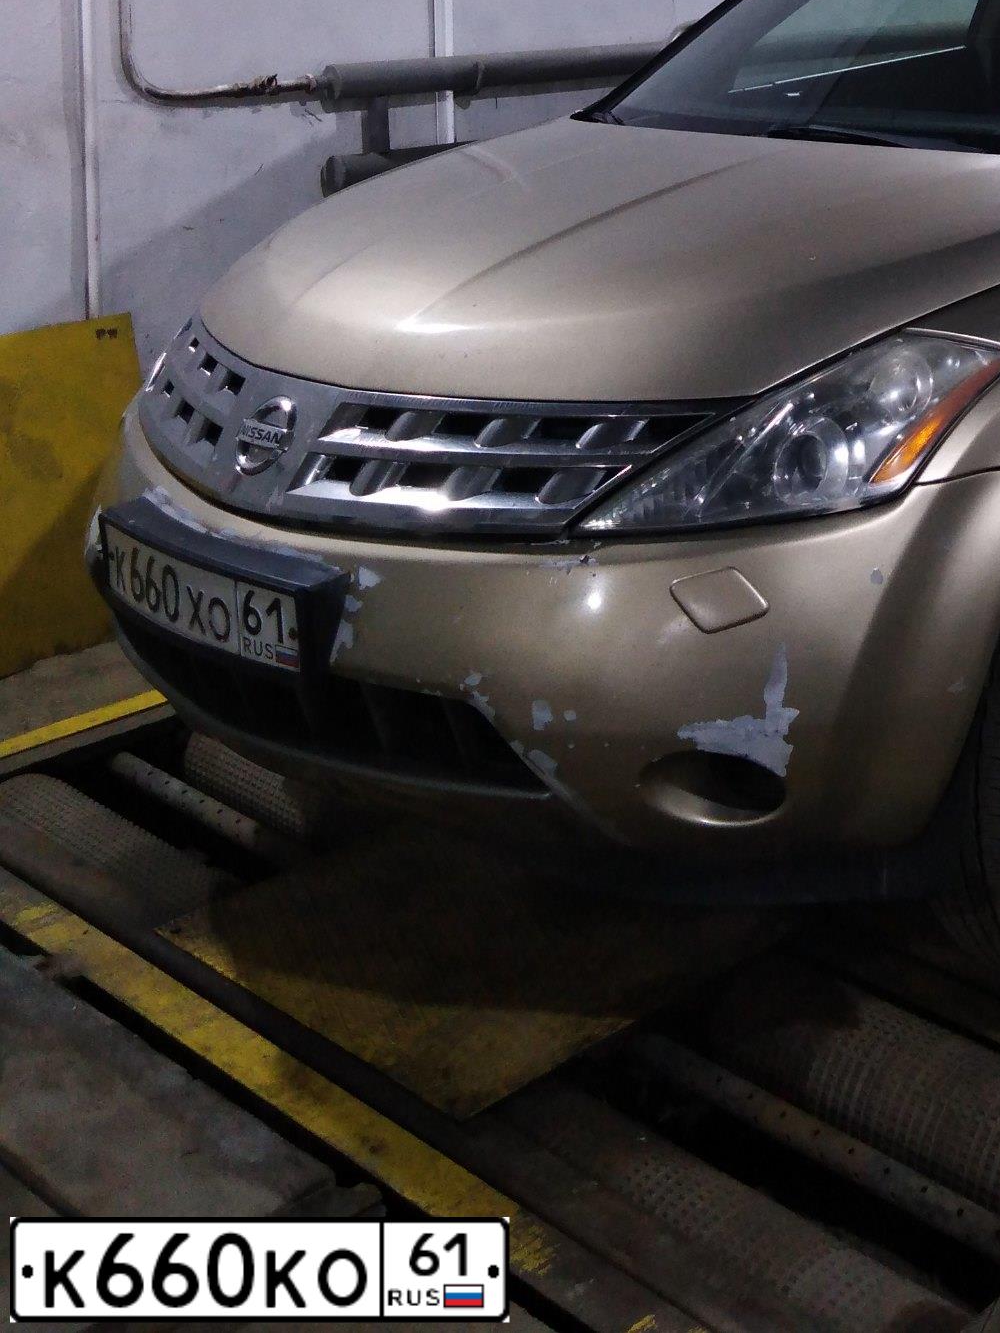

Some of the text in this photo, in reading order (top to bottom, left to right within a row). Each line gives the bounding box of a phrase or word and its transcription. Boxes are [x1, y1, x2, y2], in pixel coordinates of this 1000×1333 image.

[240, 424, 281, 444] NISSAN
[243, 589, 284, 644] 61
[242, 636, 275, 660] RUS
